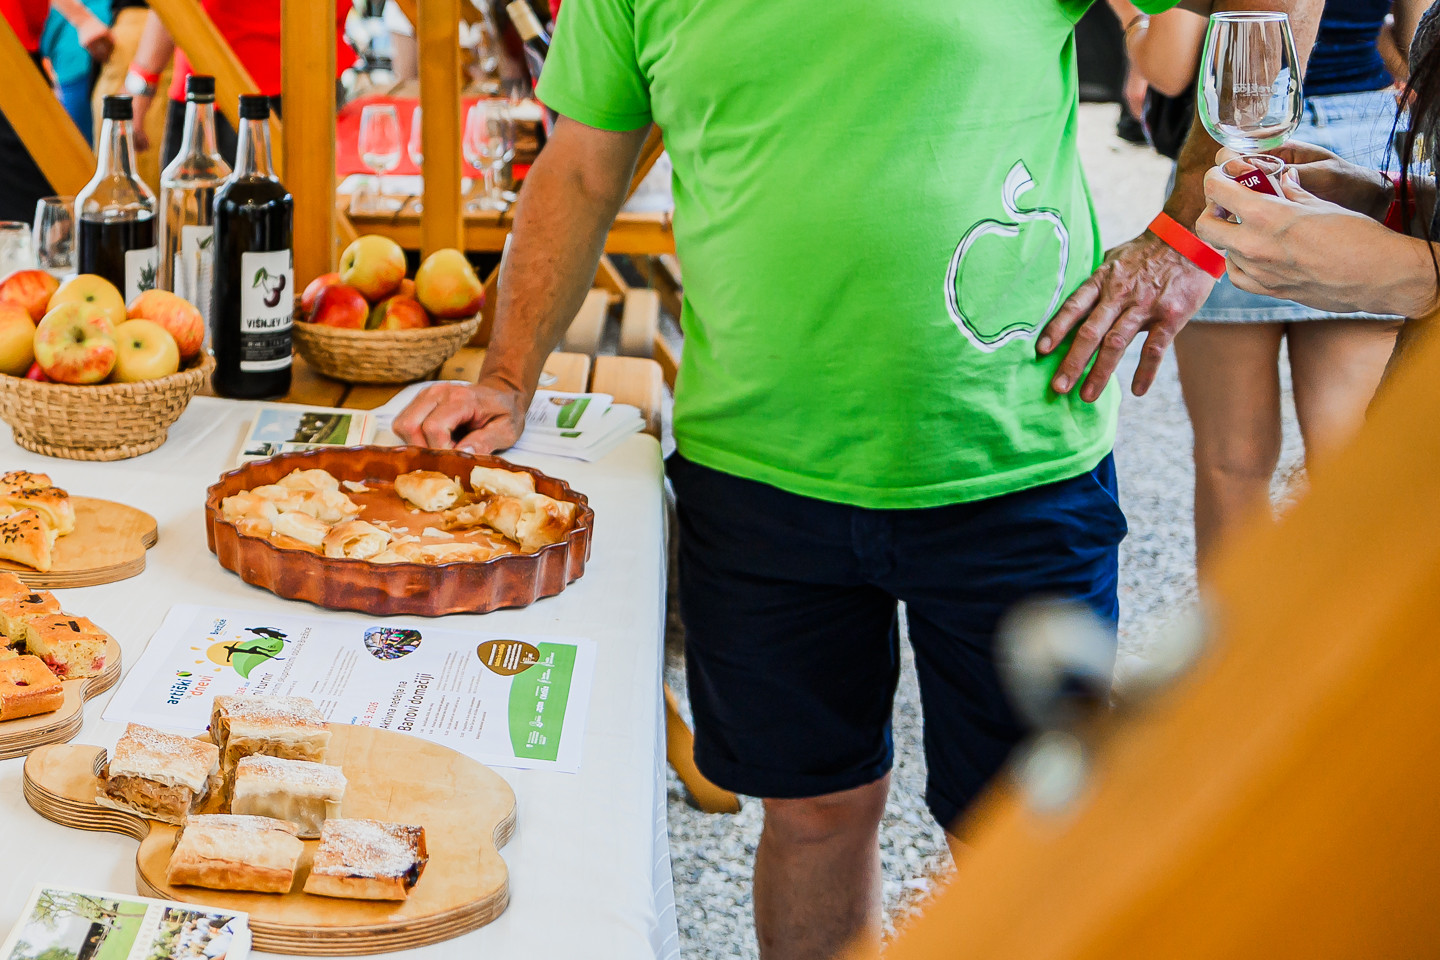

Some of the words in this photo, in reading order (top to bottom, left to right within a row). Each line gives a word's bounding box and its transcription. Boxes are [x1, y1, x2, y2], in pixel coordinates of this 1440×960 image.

[246, 316, 281, 329] VIŠNJEV
[167, 678, 192, 705] artiški
[190, 674, 214, 696] dnevi
[407, 672, 435, 705] domačiji
[397, 705, 420, 732] Banovi
